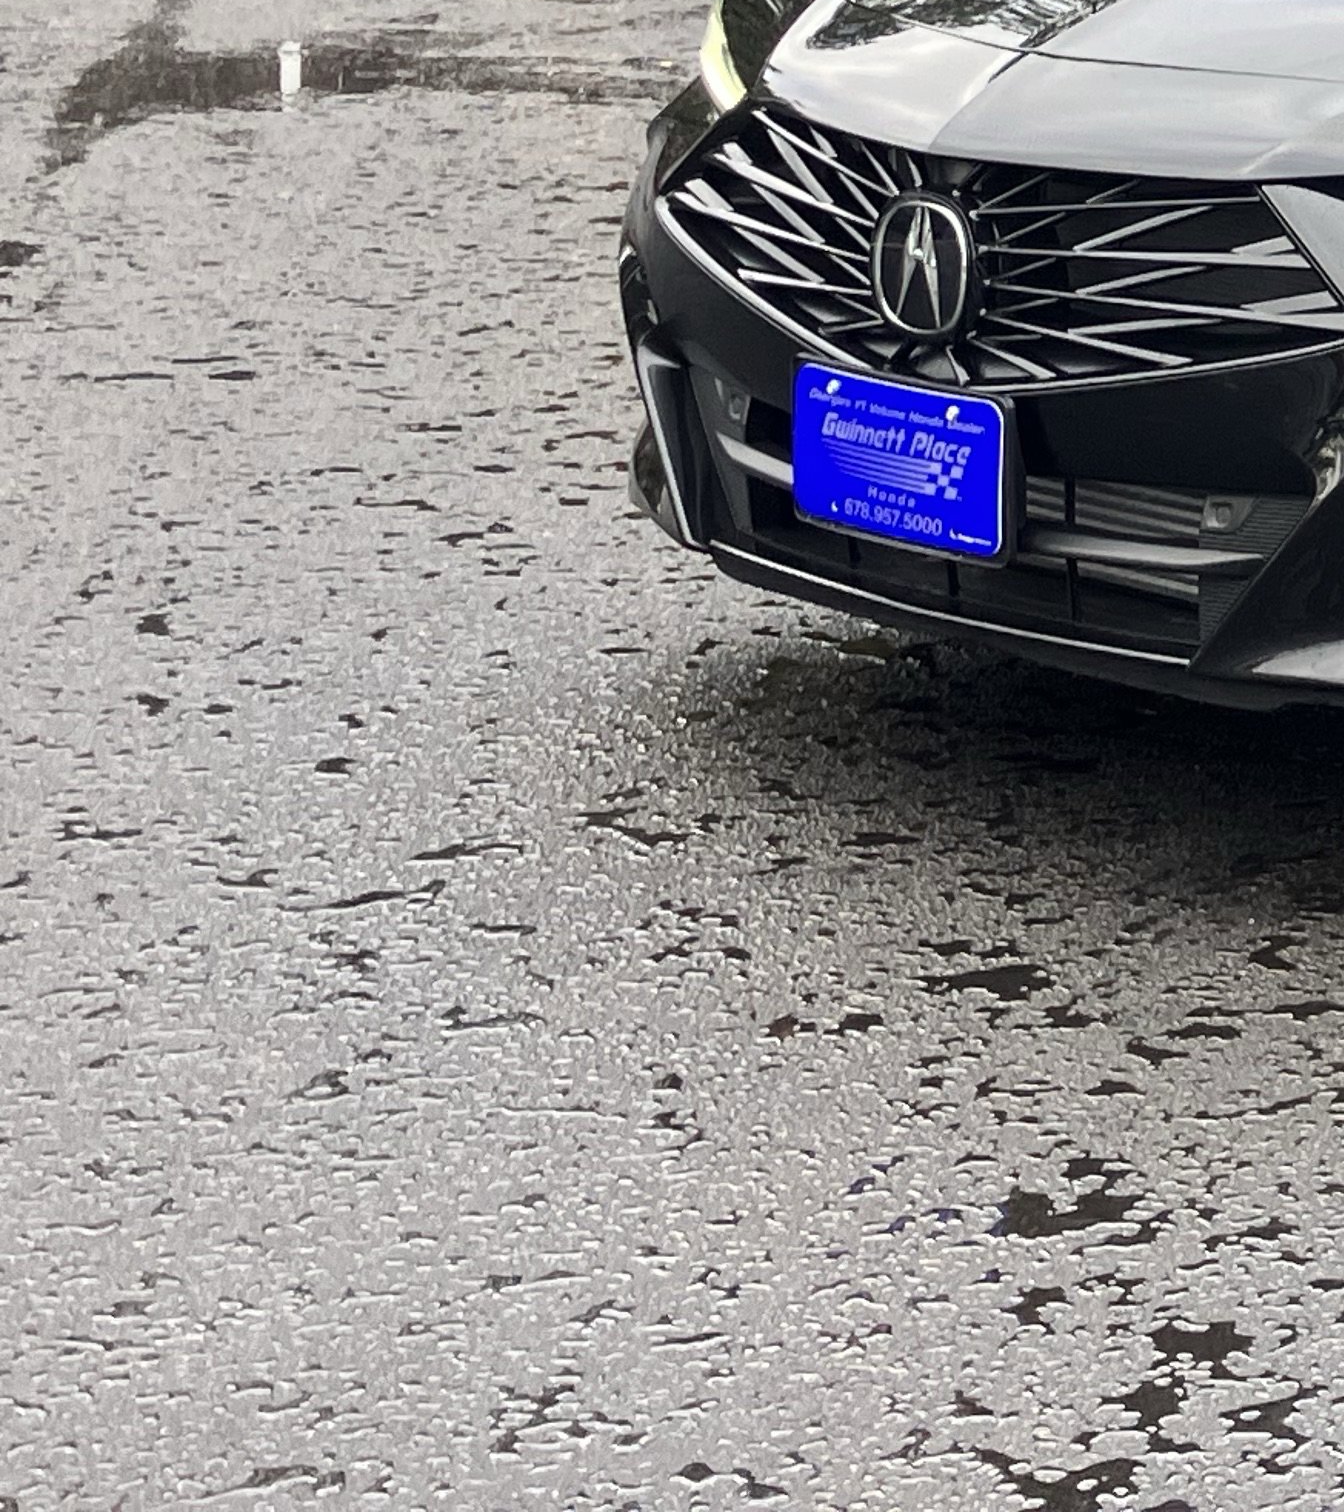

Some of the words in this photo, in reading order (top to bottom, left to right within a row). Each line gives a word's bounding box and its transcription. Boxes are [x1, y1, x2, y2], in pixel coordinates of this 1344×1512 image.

[821, 411, 906, 454] Gwinnett
[909, 430, 972, 466] Place
[867, 484, 916, 508] Honda
[844, 497, 942, 537] 678.957.5000
